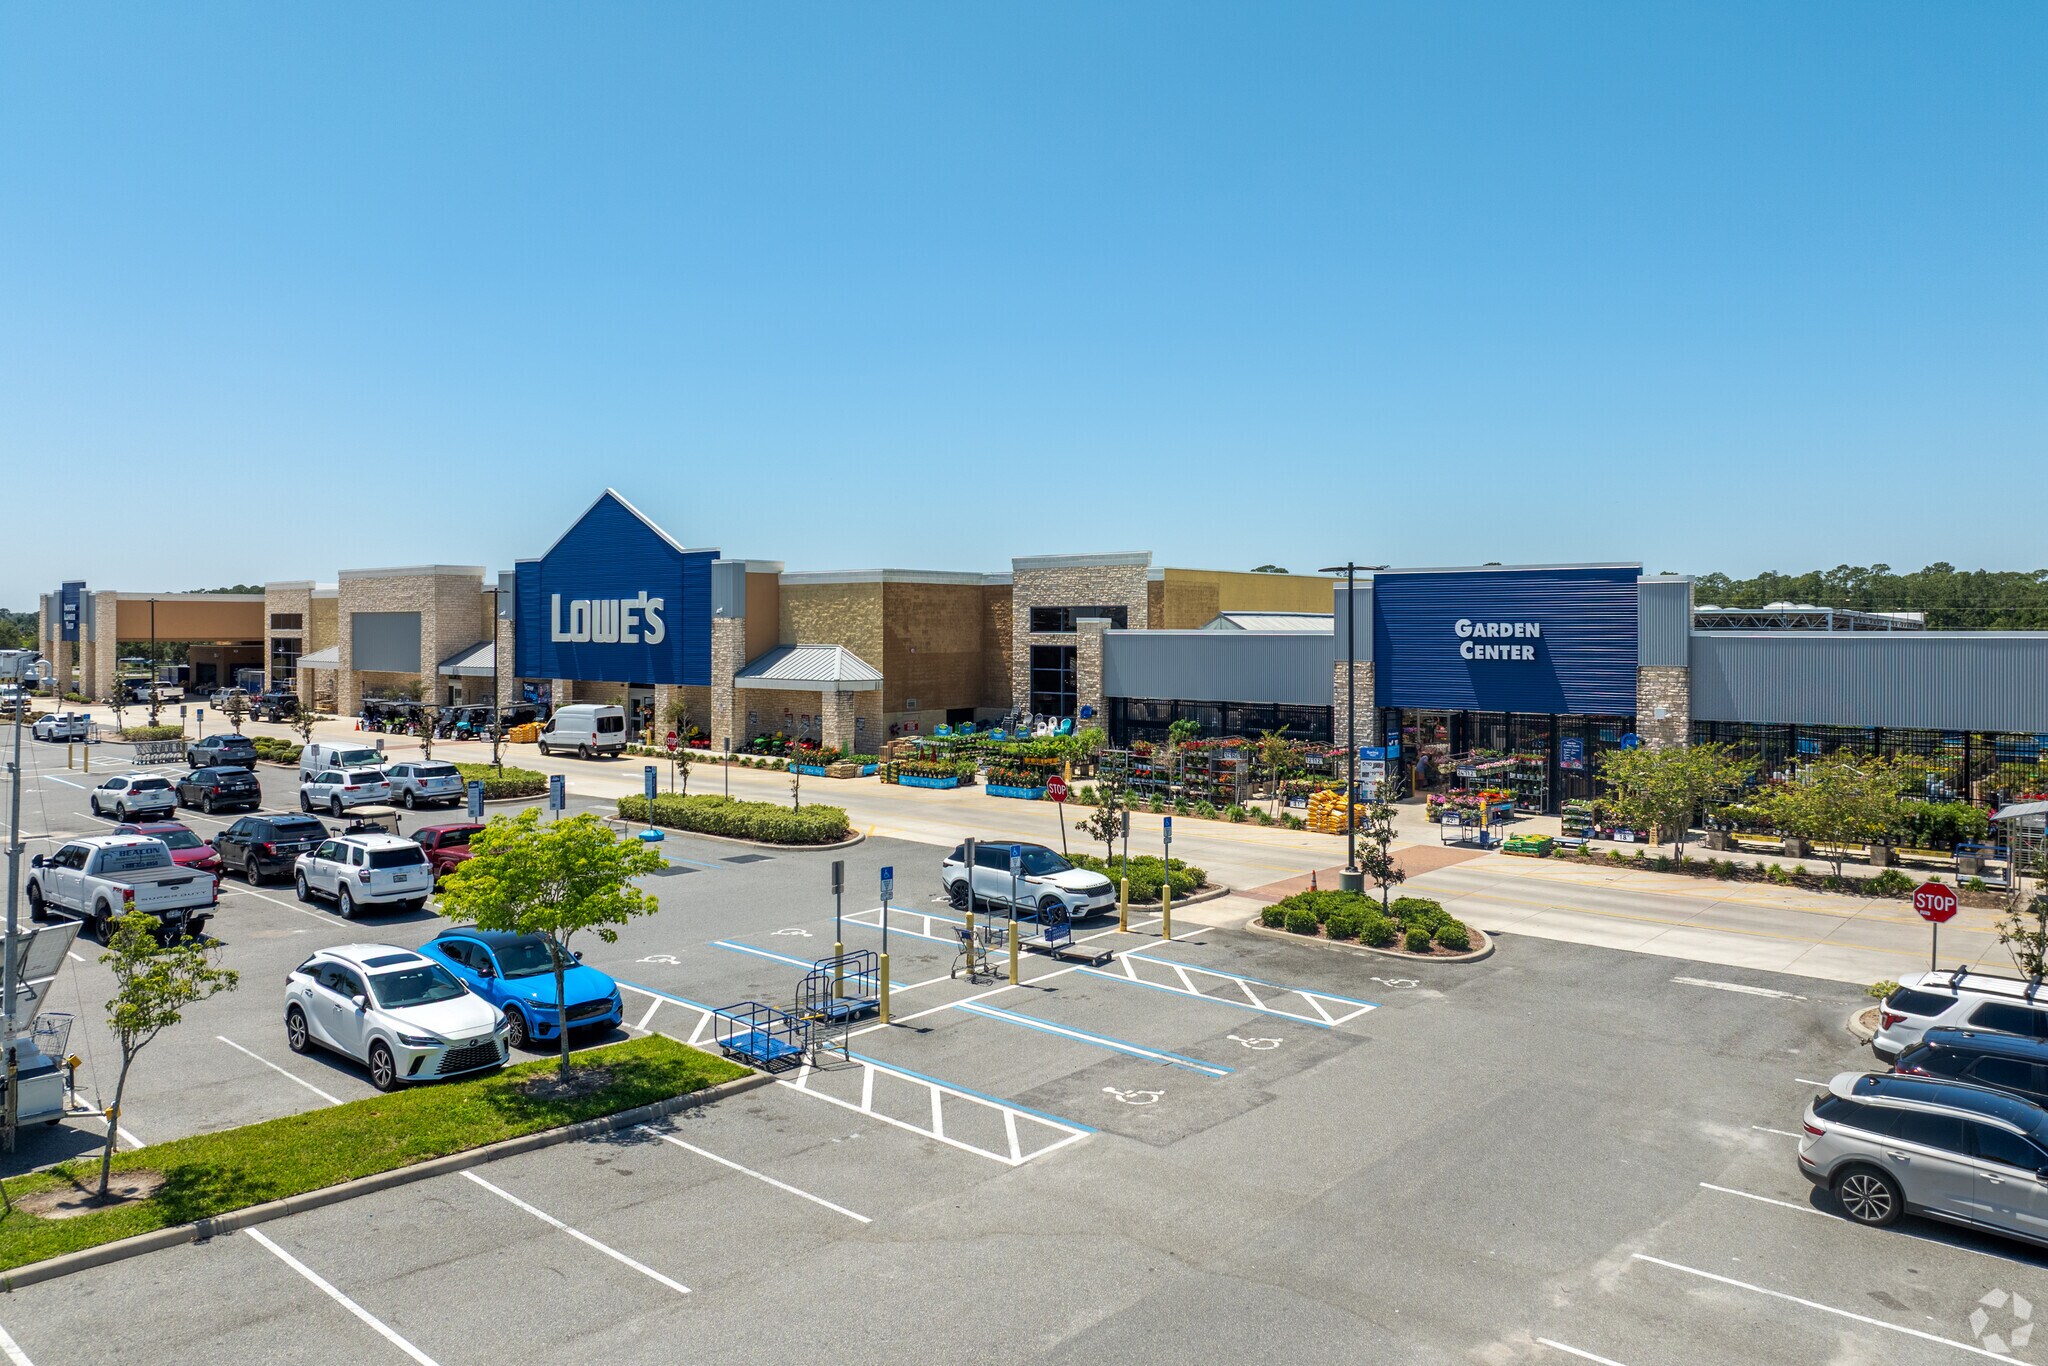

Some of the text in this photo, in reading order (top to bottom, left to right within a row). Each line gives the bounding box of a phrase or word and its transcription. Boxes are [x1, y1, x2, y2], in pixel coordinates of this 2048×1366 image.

[551, 591, 665, 645] LOWE'S
[1454, 618, 1540, 638] GARDEN
[1460, 640, 1535, 660] CENTER
[1048, 783, 1067, 796] STOP
[119, 847, 160, 857] BEACON
[1916, 892, 1955, 912] STOP
